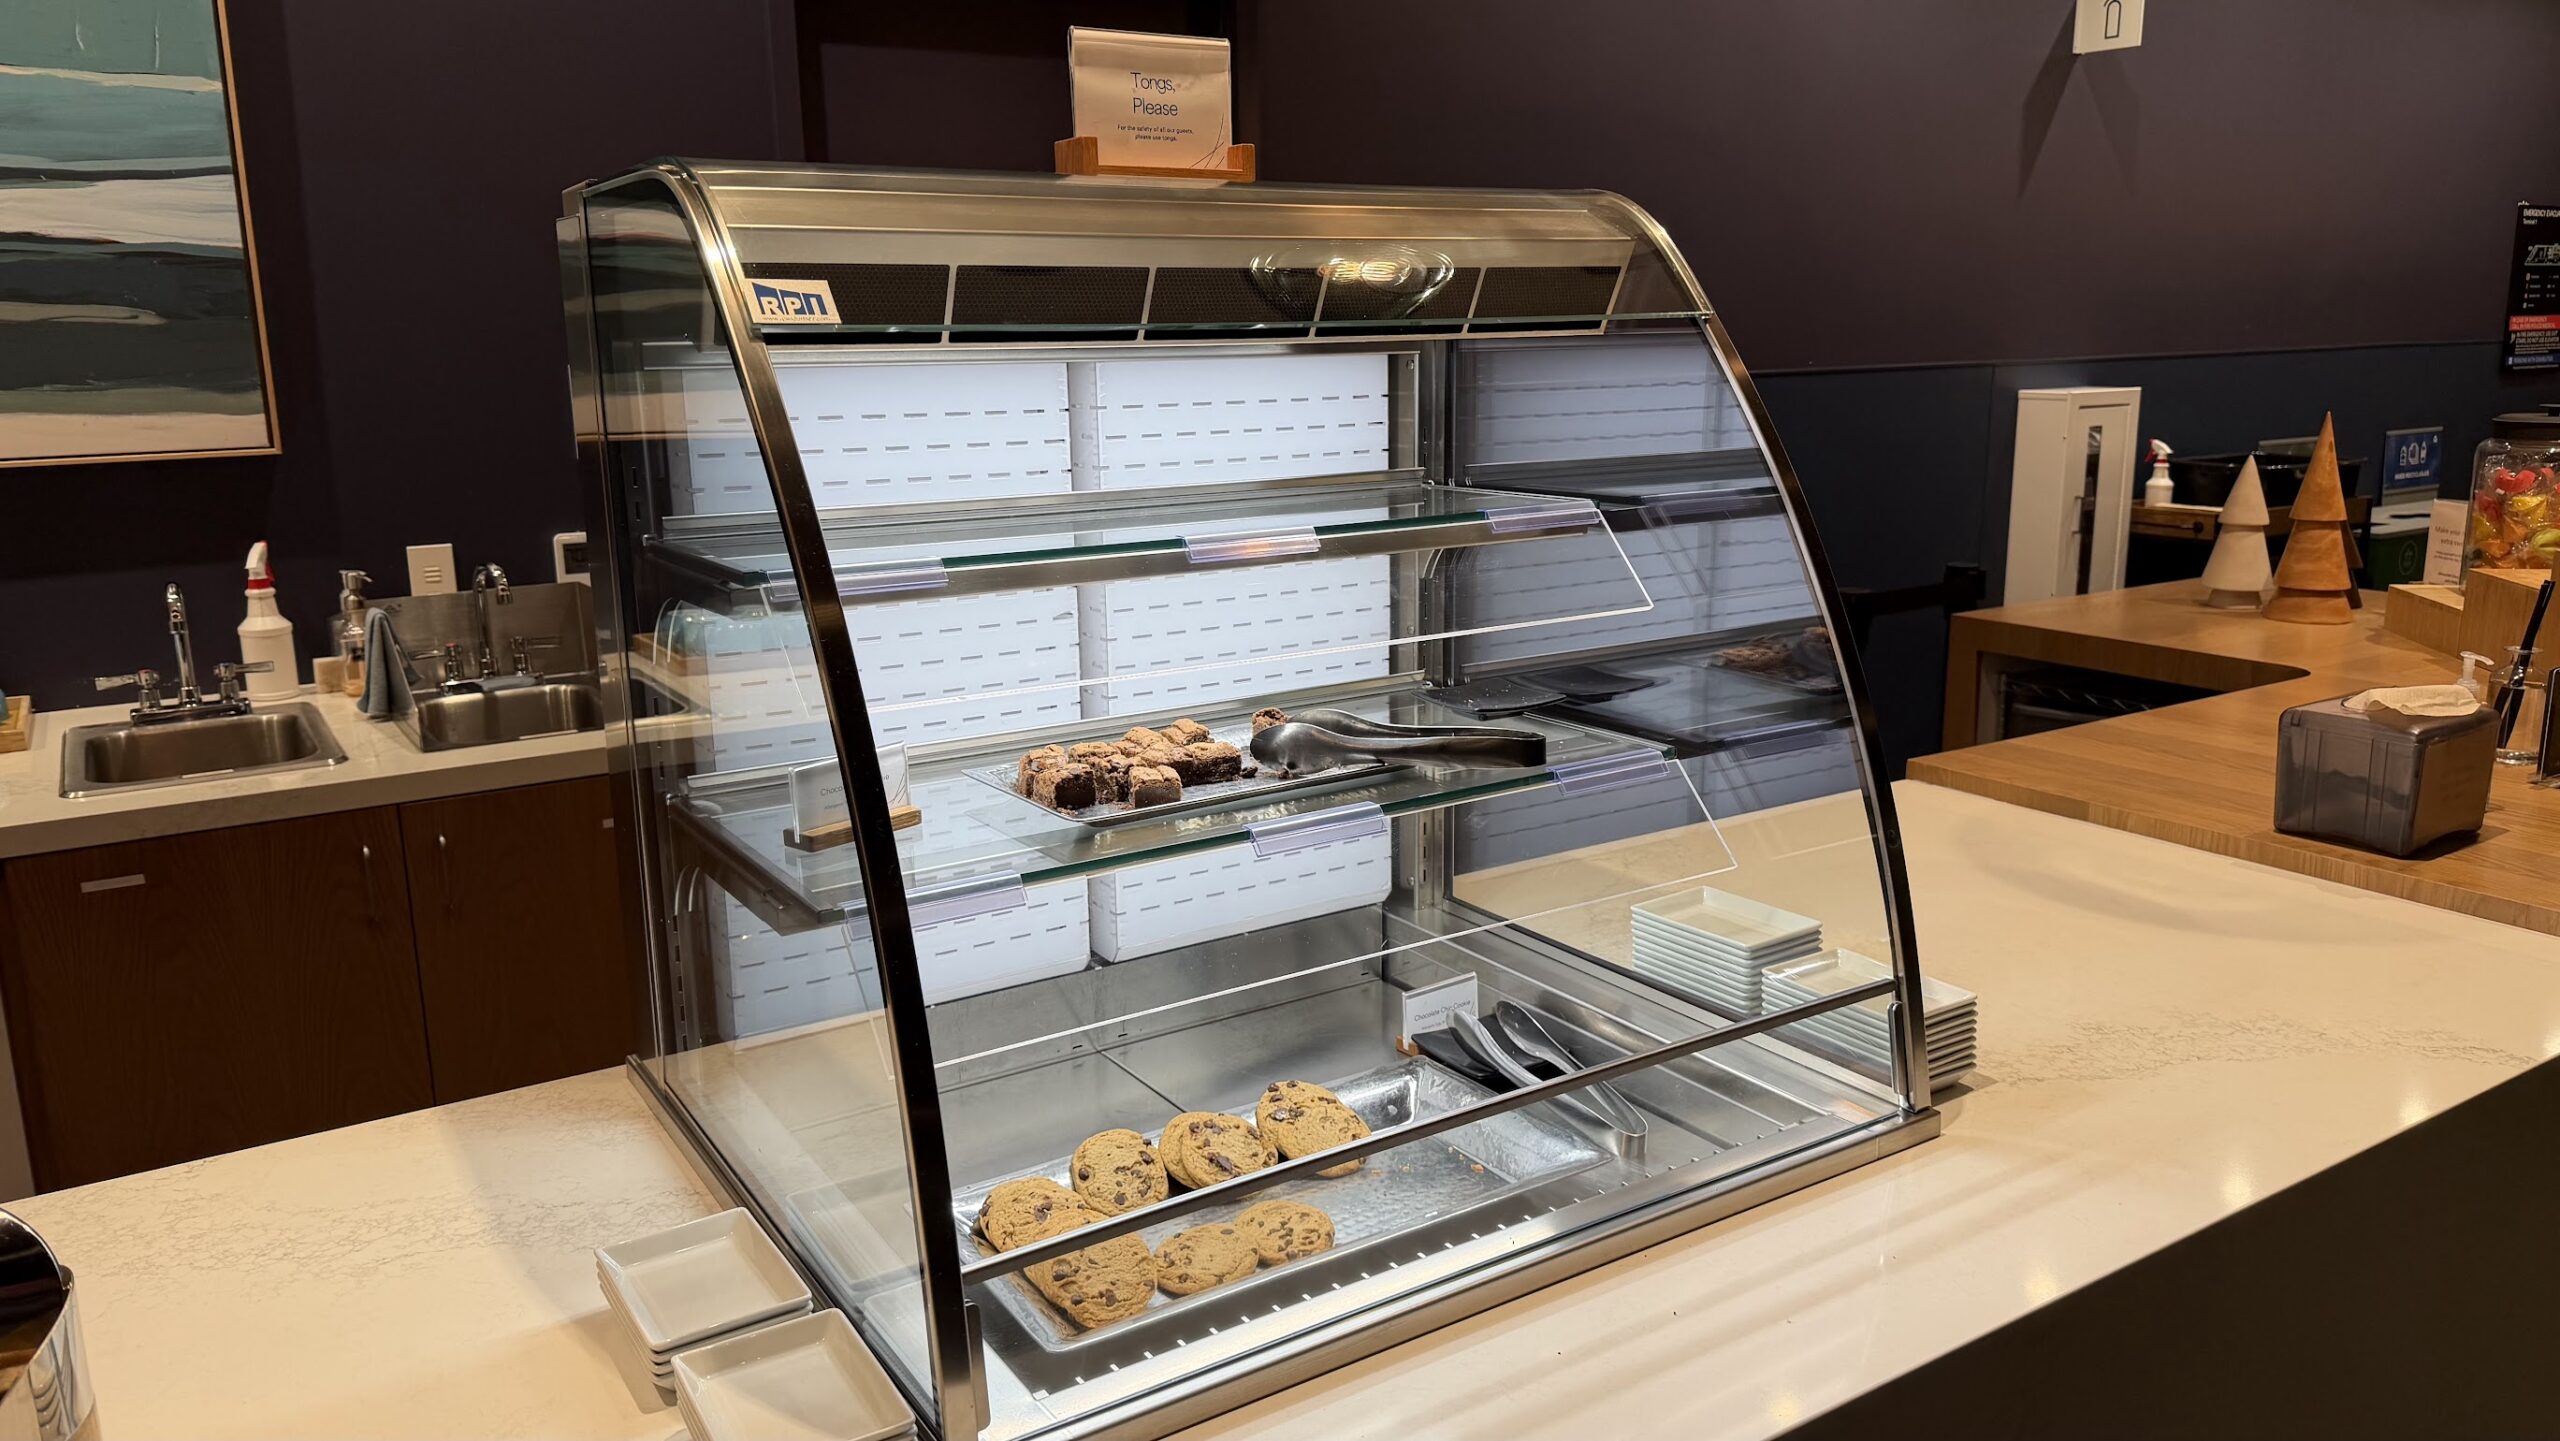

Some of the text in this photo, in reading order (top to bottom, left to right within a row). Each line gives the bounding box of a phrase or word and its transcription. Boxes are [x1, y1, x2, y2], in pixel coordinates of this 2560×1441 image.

[1130, 71, 1176, 94] Tongs,
[1132, 97, 1179, 116] Please
[1414, 1009, 1440, 1021] Chocolate
[1453, 1000, 1471, 1009] Cookie
